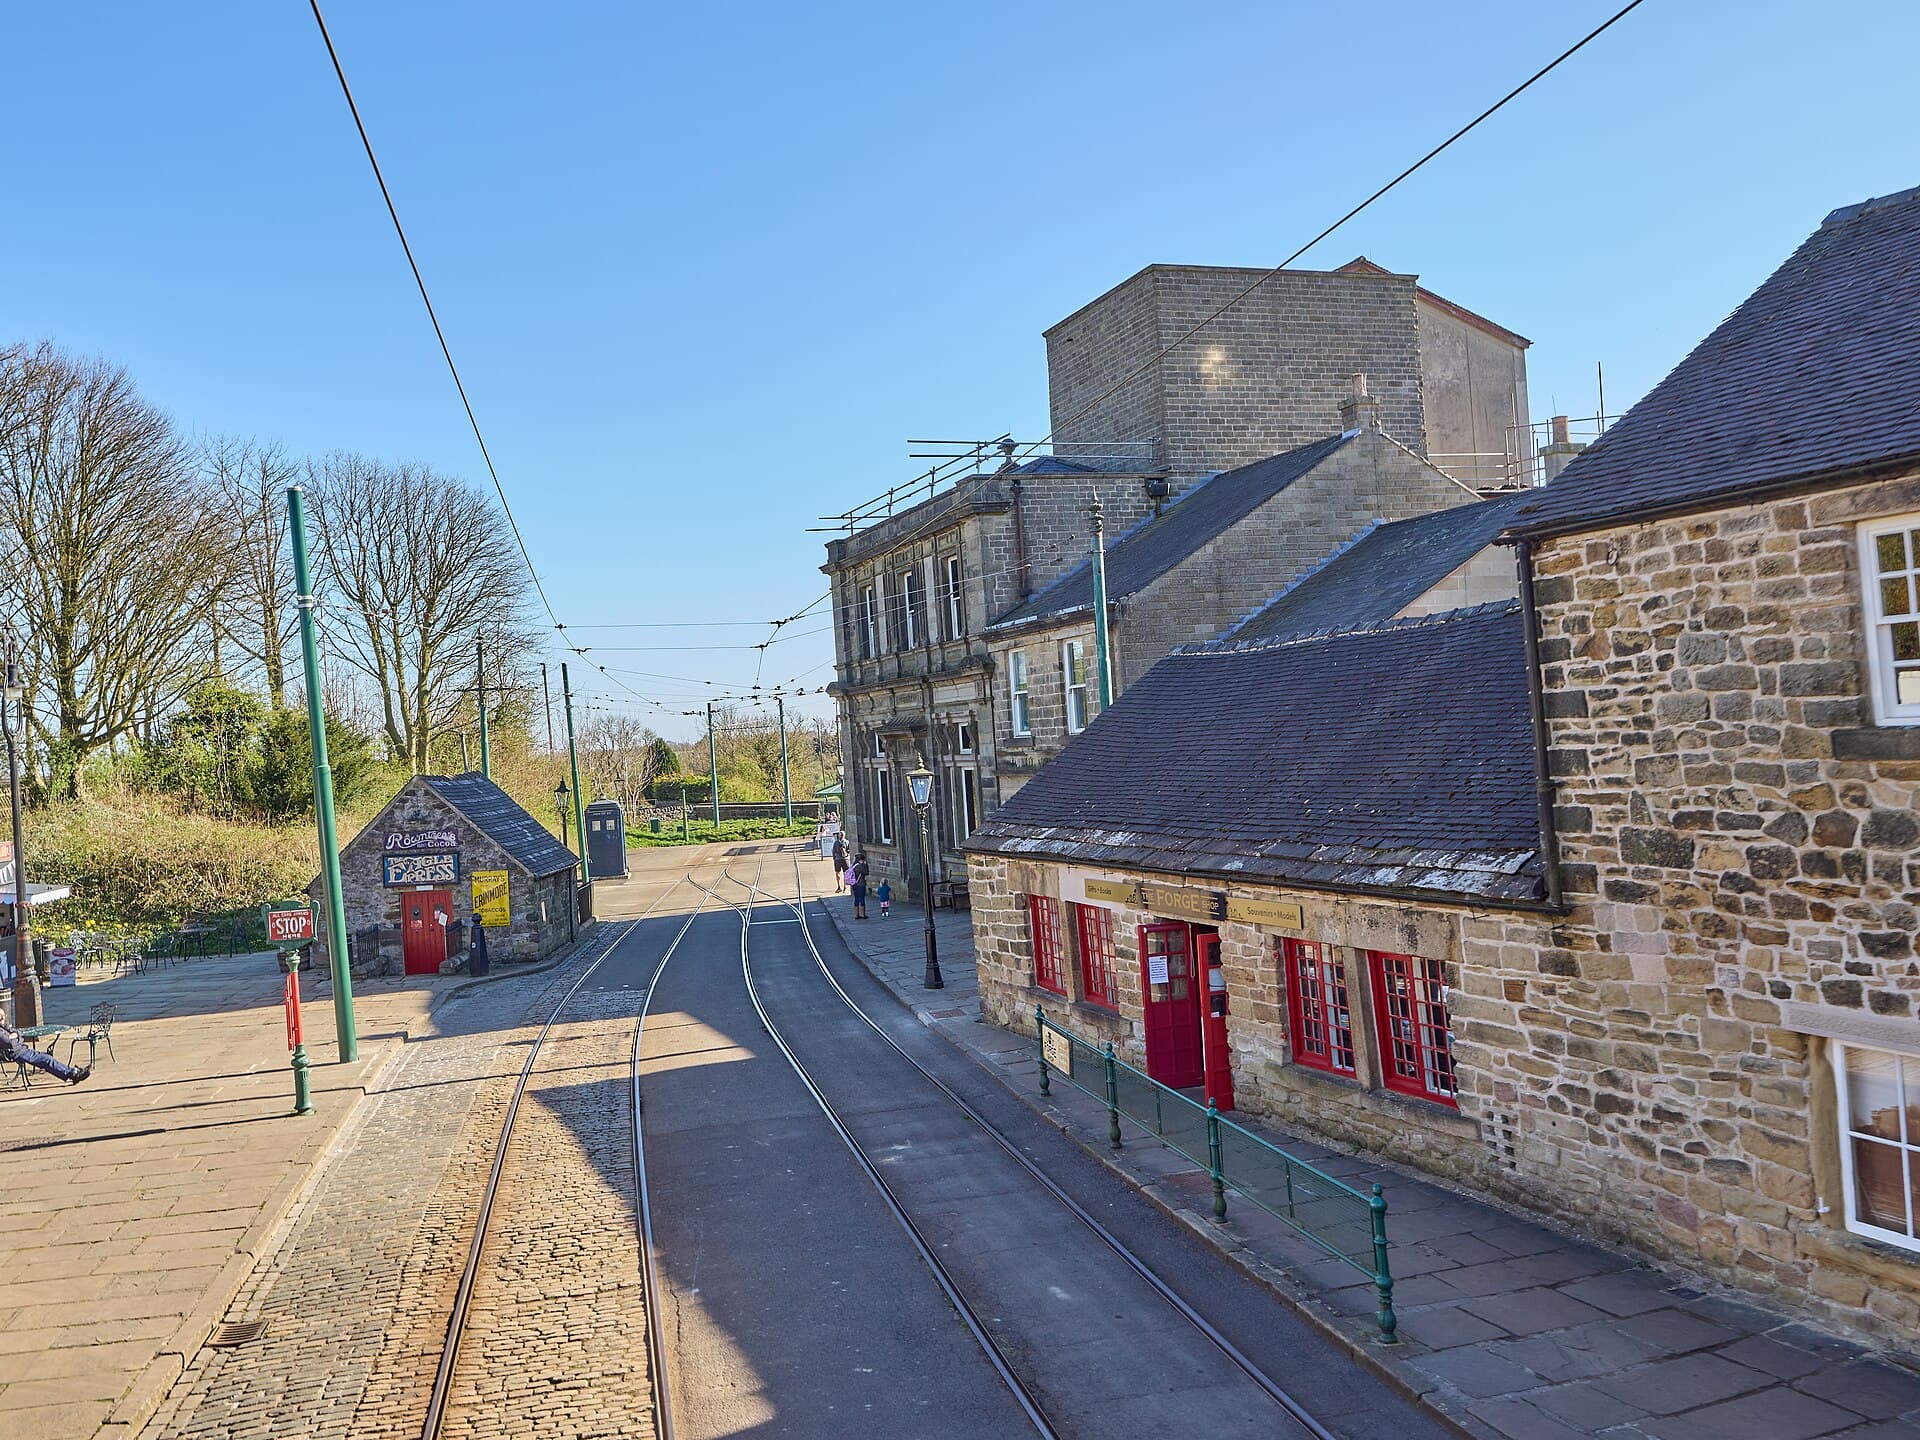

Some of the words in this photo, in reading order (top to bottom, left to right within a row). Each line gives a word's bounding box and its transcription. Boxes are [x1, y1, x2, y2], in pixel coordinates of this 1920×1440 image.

[1141, 892, 1155, 903] THE
[1156, 889, 1201, 912] FORGE
[1202, 900, 1219, 911] SHOP
[275, 916, 307, 936] STOP
